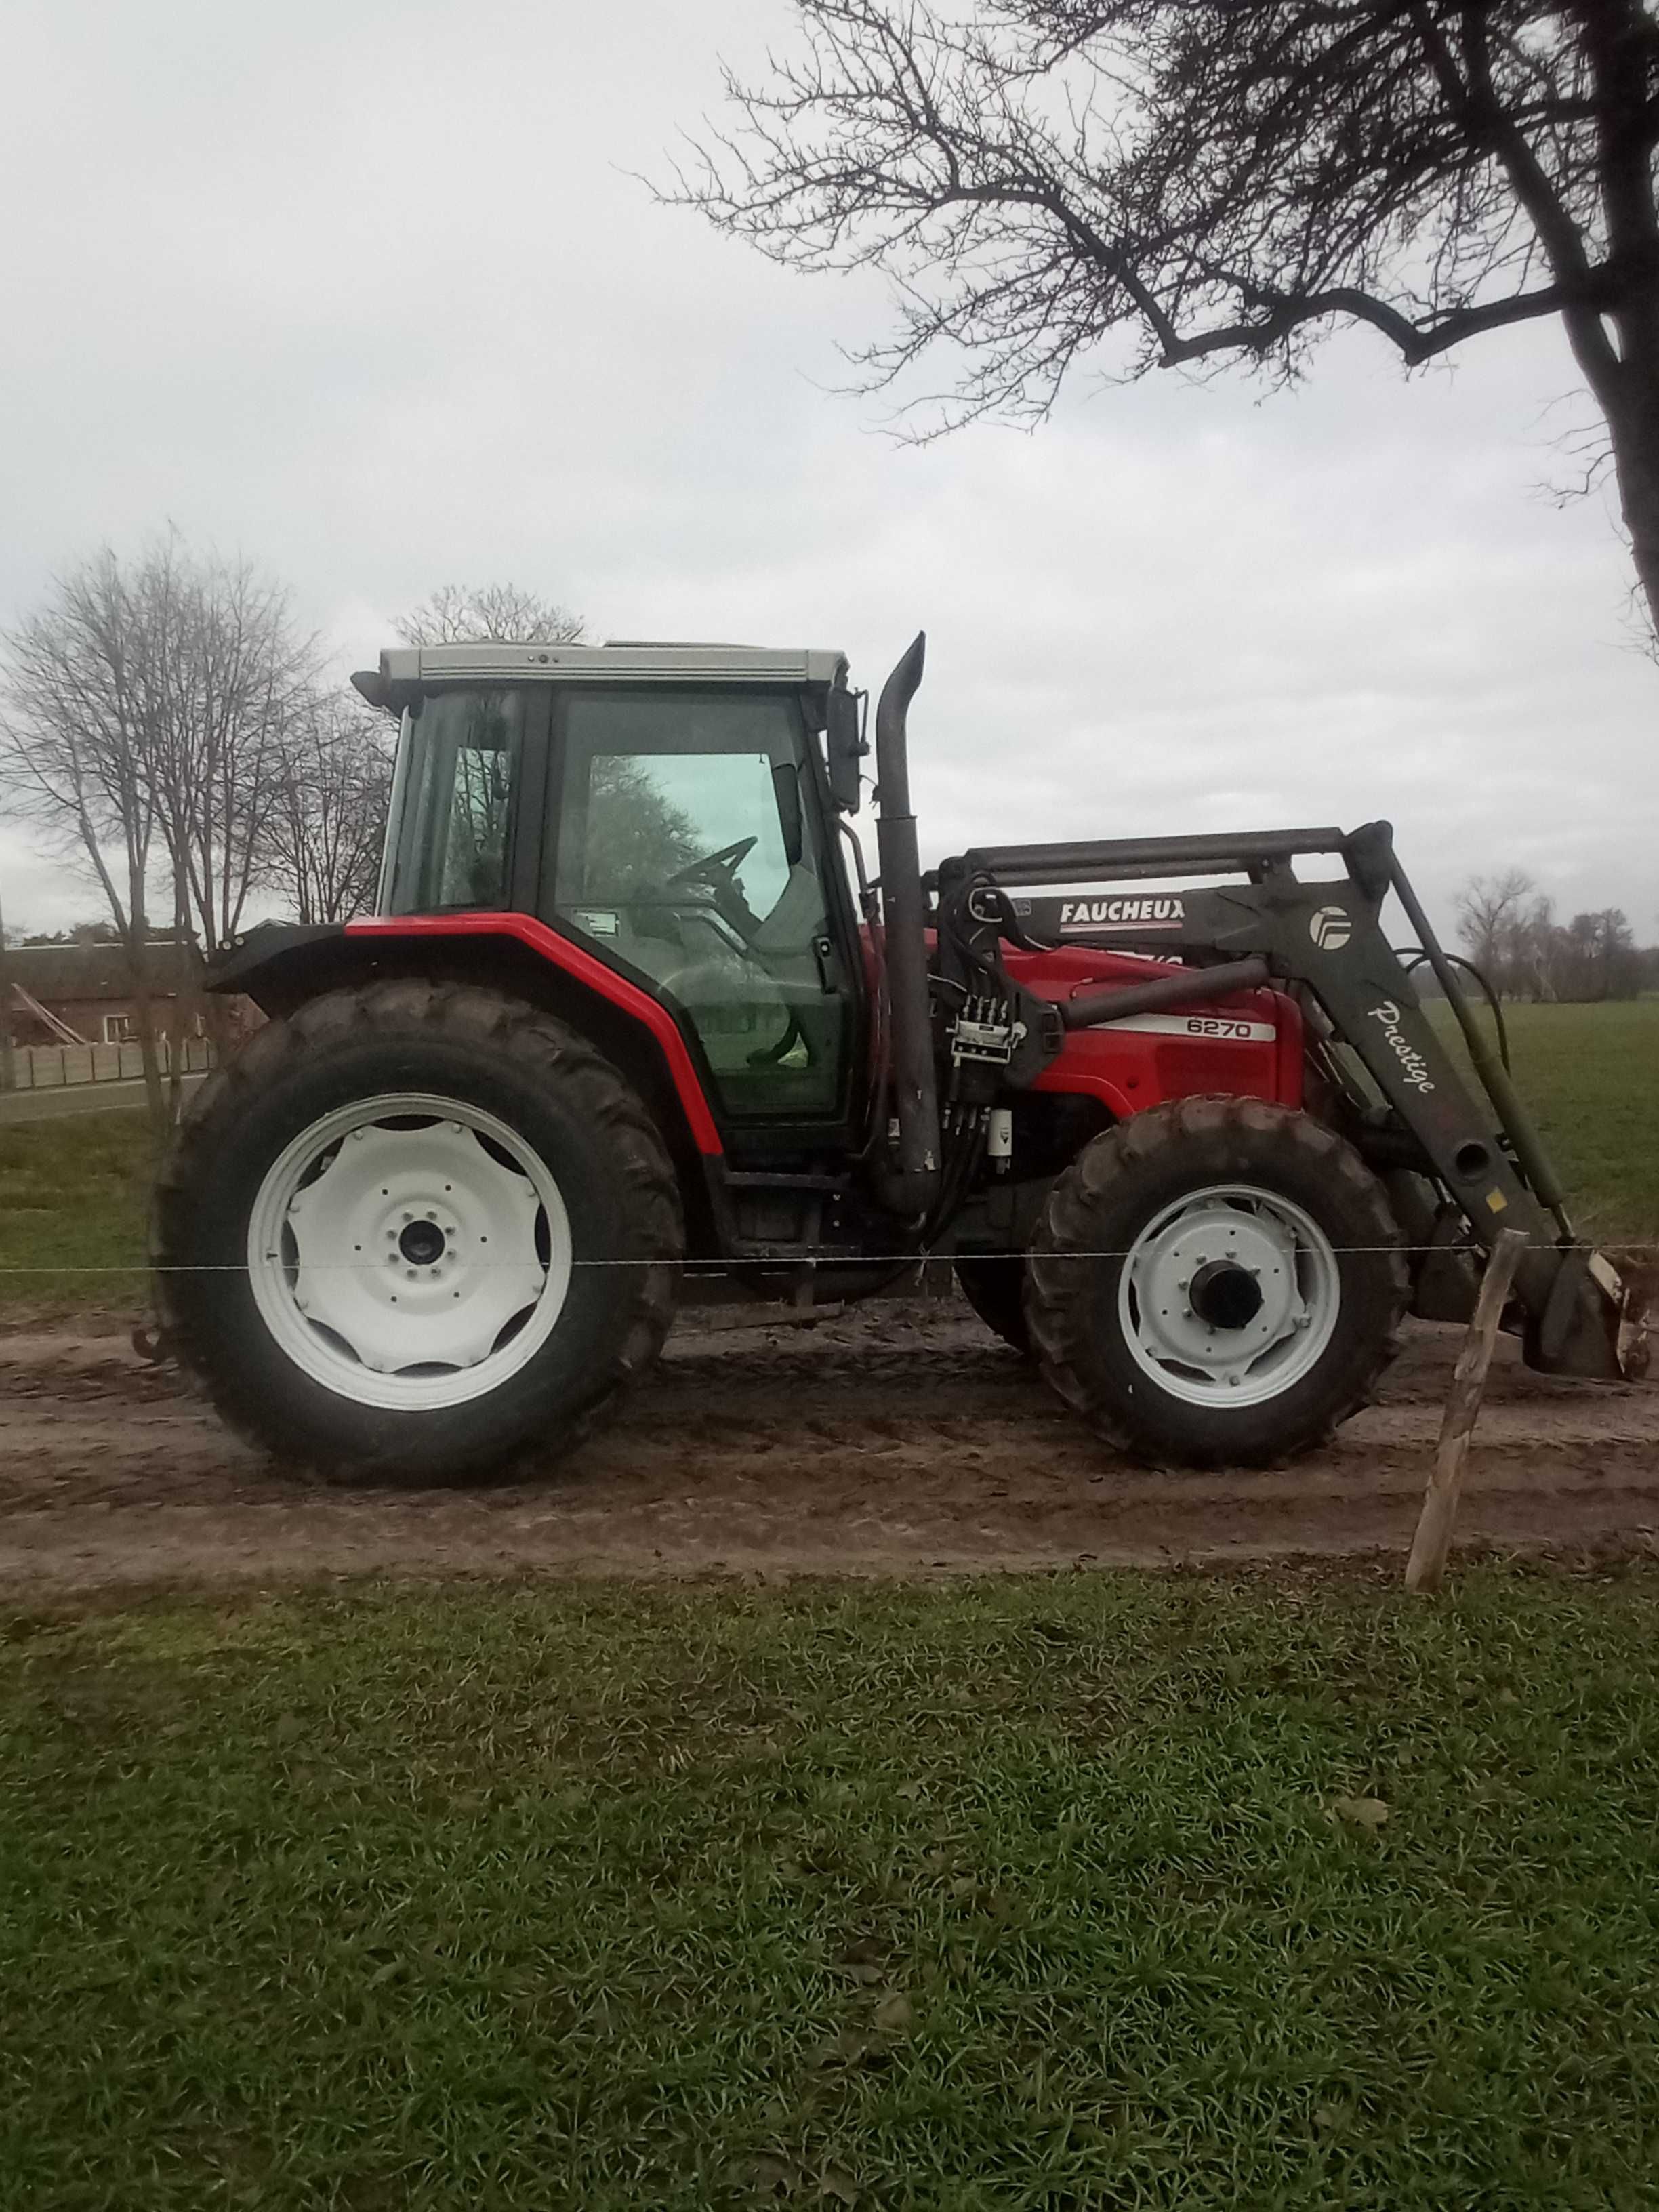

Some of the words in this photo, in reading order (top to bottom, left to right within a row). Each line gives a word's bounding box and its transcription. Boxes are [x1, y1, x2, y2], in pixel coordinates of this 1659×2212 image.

[1060, 899, 1185, 922] FAUCHEUX
[1187, 1019, 1251, 1038] 6270
[1367, 1000, 1435, 1093] Prestige
